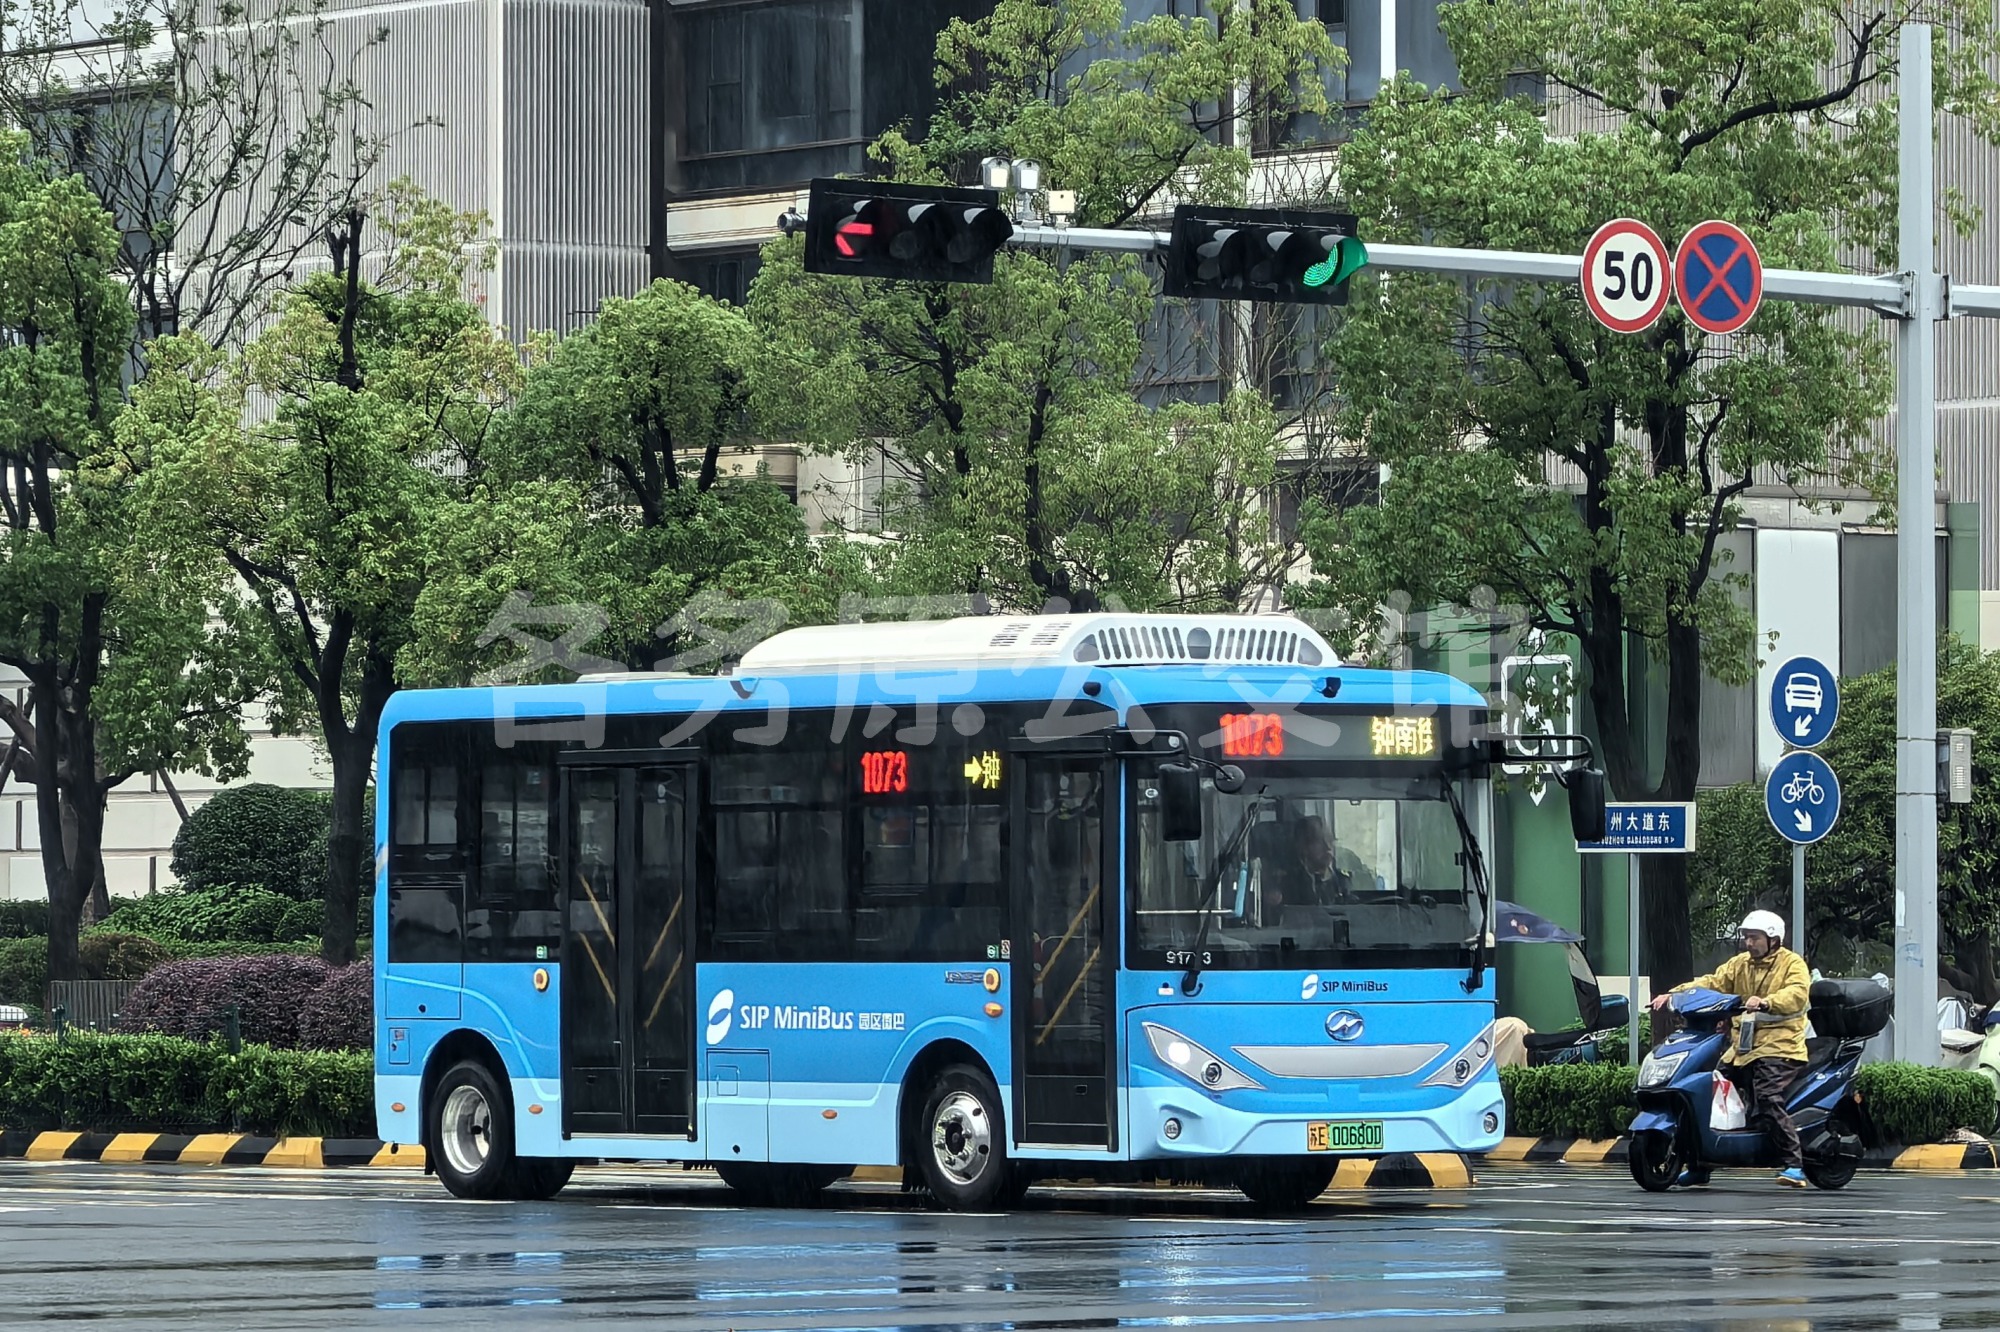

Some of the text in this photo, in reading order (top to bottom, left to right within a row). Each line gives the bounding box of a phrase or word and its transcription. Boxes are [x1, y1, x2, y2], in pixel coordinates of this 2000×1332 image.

[1603, 250, 1653, 301] 50
[1220, 713, 1283, 756] 1073
[861, 751, 907, 793] 1073
[1610, 811, 1670, 831] 州大道东
[1166, 951, 1211, 964] 9173
[1322, 981, 1389, 992] SIP MiniBus
[740, 1005, 770, 1029] SIP
[774, 1005, 854, 1030] MiniBus
